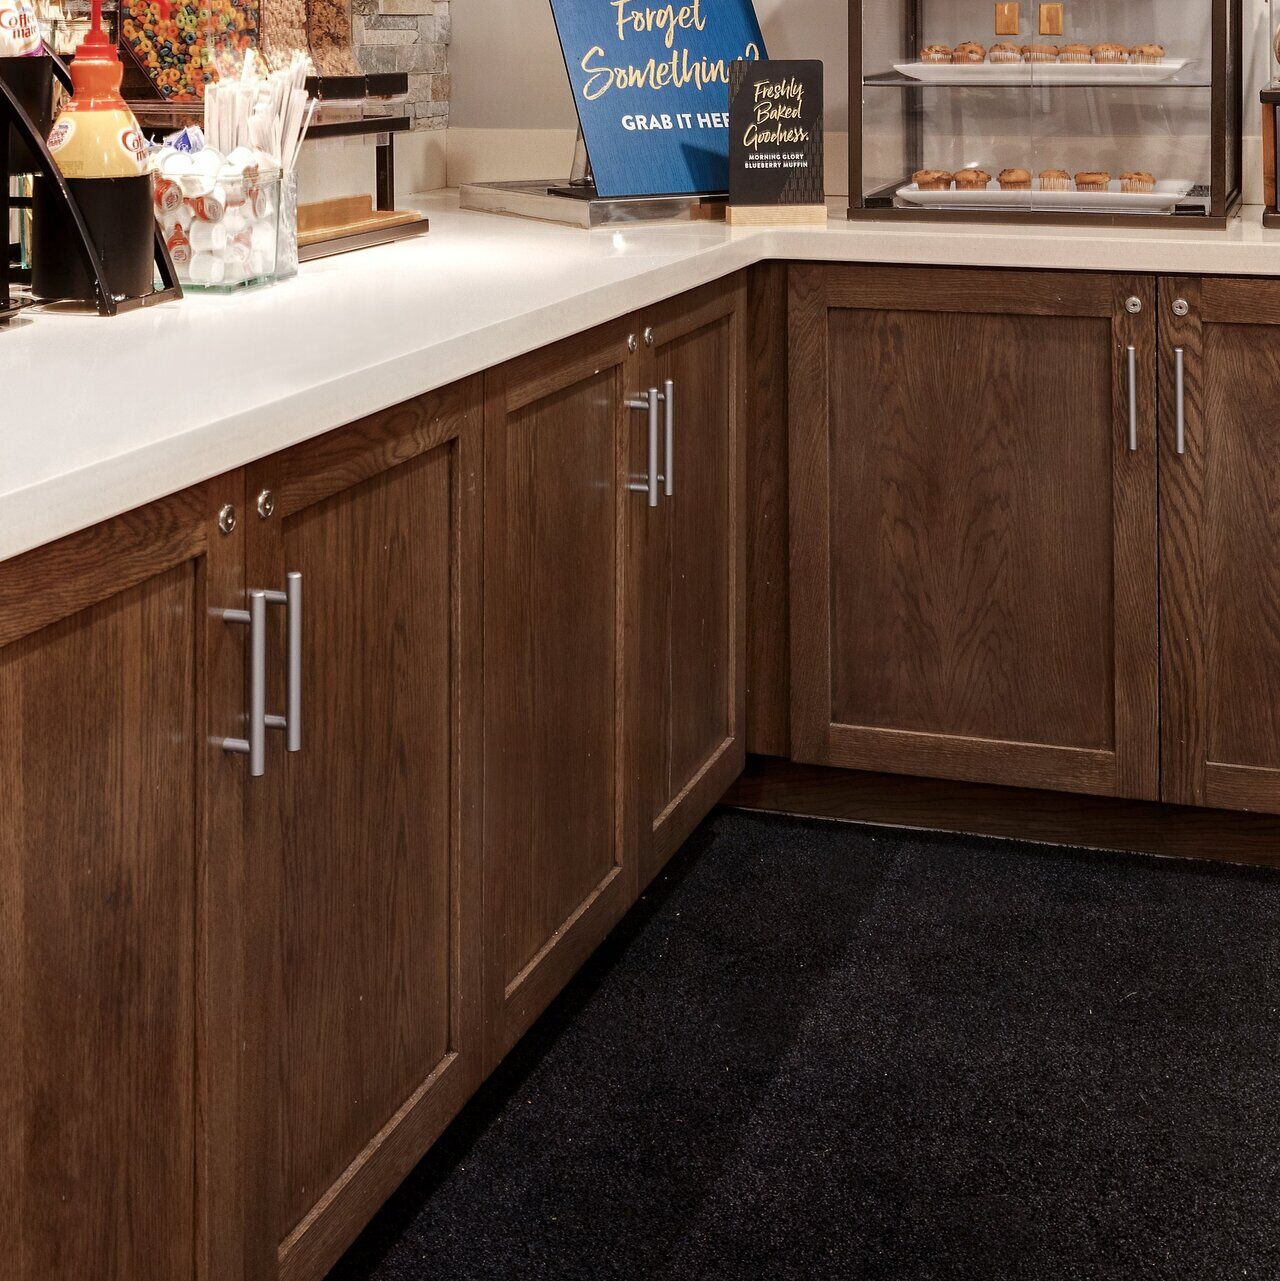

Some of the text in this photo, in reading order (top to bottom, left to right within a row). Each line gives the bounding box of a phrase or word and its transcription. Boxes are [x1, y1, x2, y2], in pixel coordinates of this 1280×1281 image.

[753, 77, 804, 103] Freshly
[621, 115, 673, 131] GRAB
[676, 113, 692, 129] IT
[753, 99, 803, 125] Baked
[743, 123, 810, 151] Goodness.
[744, 161, 808, 169] BLUEBERRY MUFFIN
[748, 153, 804, 161] MORNING GLORY
